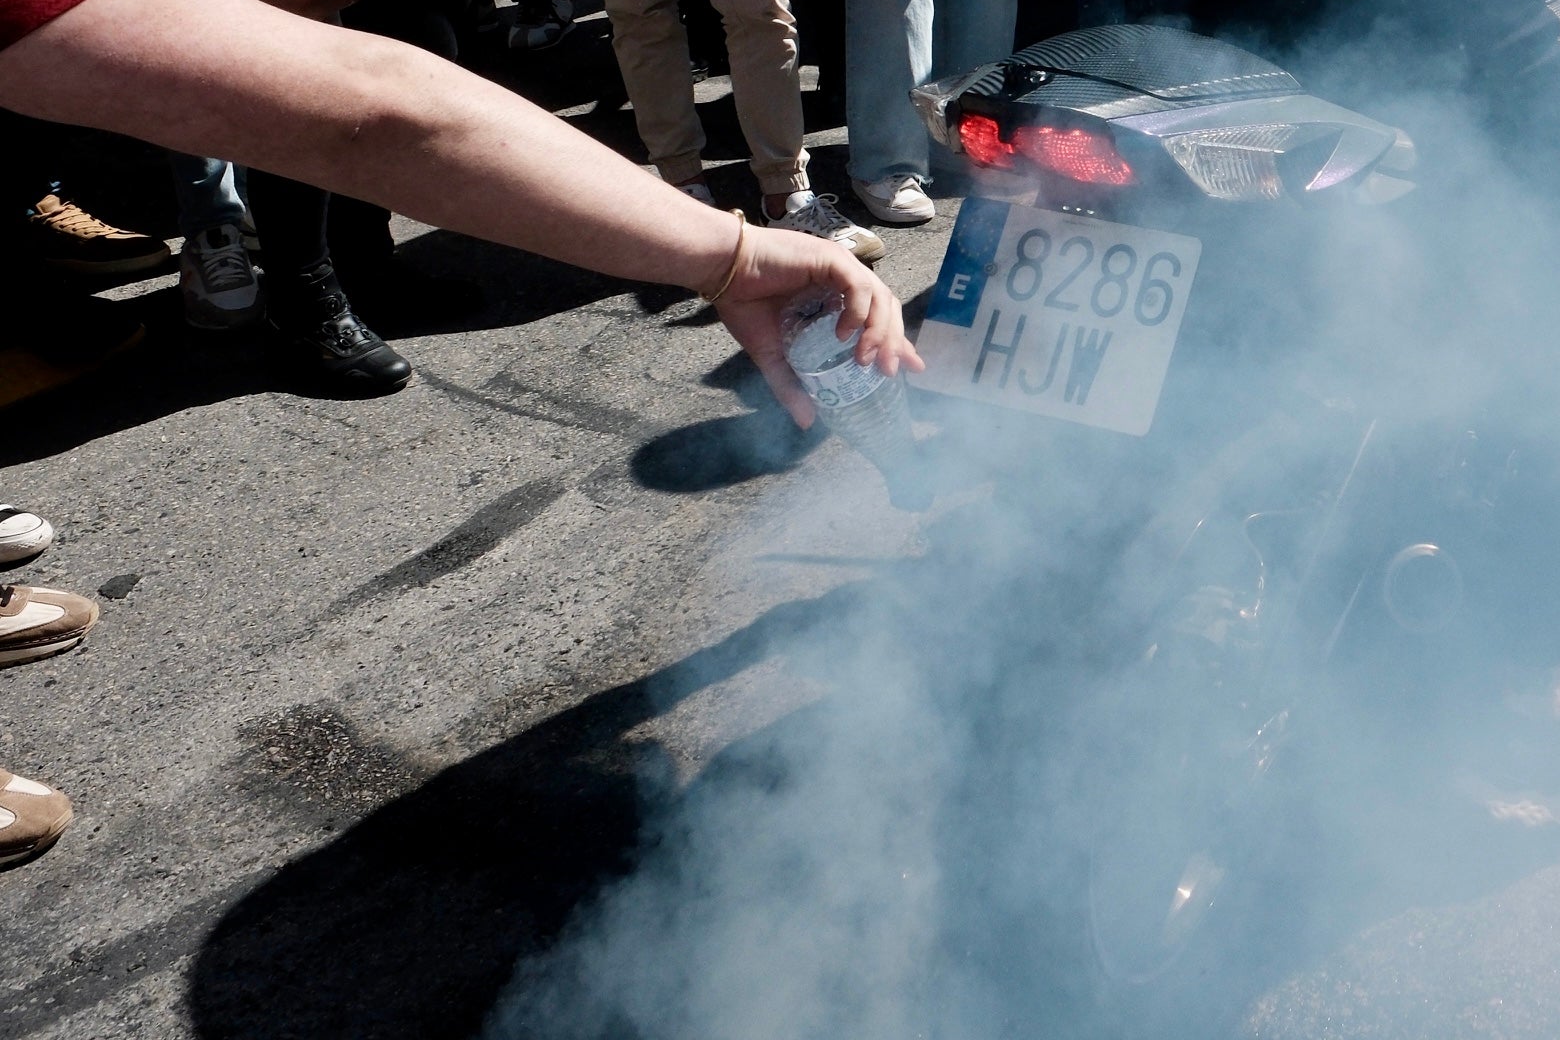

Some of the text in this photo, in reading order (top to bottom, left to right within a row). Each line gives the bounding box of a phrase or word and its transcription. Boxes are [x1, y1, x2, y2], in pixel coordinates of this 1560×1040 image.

[947, 272, 972, 301] E
[1005, 227, 1182, 327] 8286
[970, 309, 1114, 406] HJW
